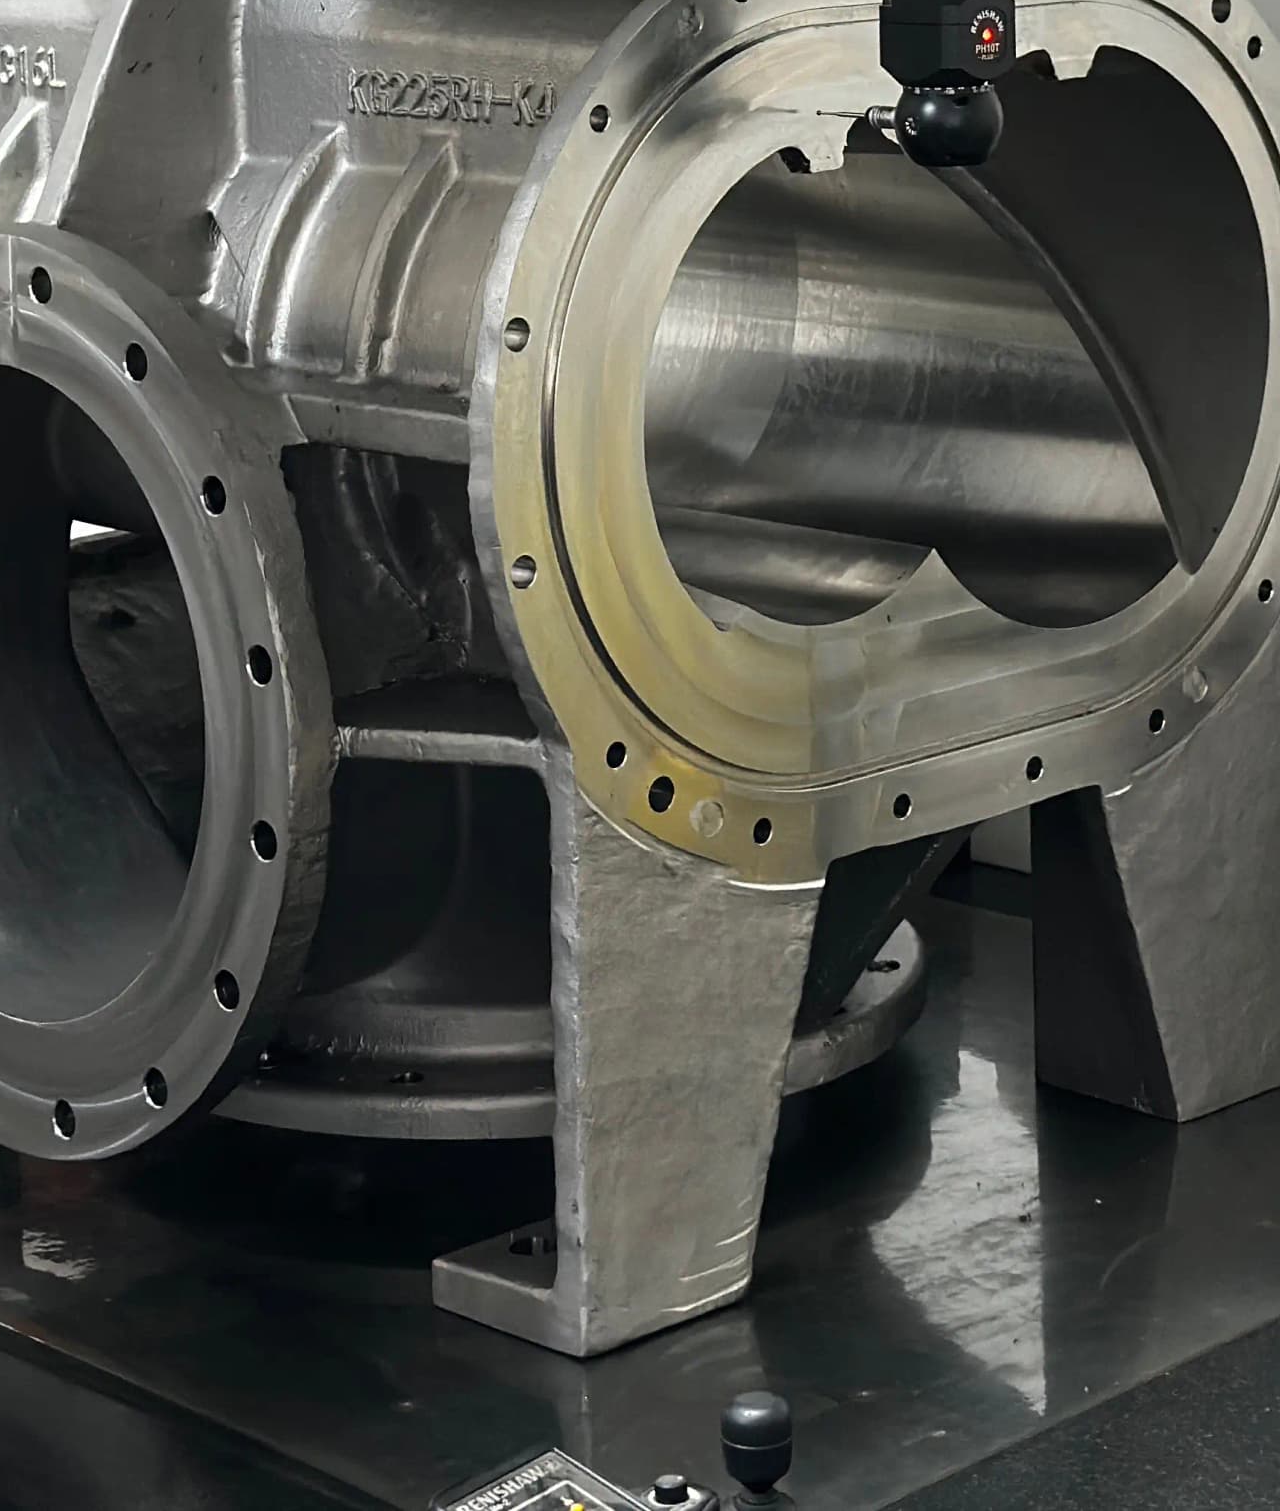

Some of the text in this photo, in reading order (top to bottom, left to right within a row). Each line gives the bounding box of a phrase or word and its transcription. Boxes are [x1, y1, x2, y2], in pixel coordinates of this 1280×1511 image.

[970, 9, 1005, 34] RENISHAW
[975, 42, 1000, 54] PH10T
[0, 43, 67, 89] 316L
